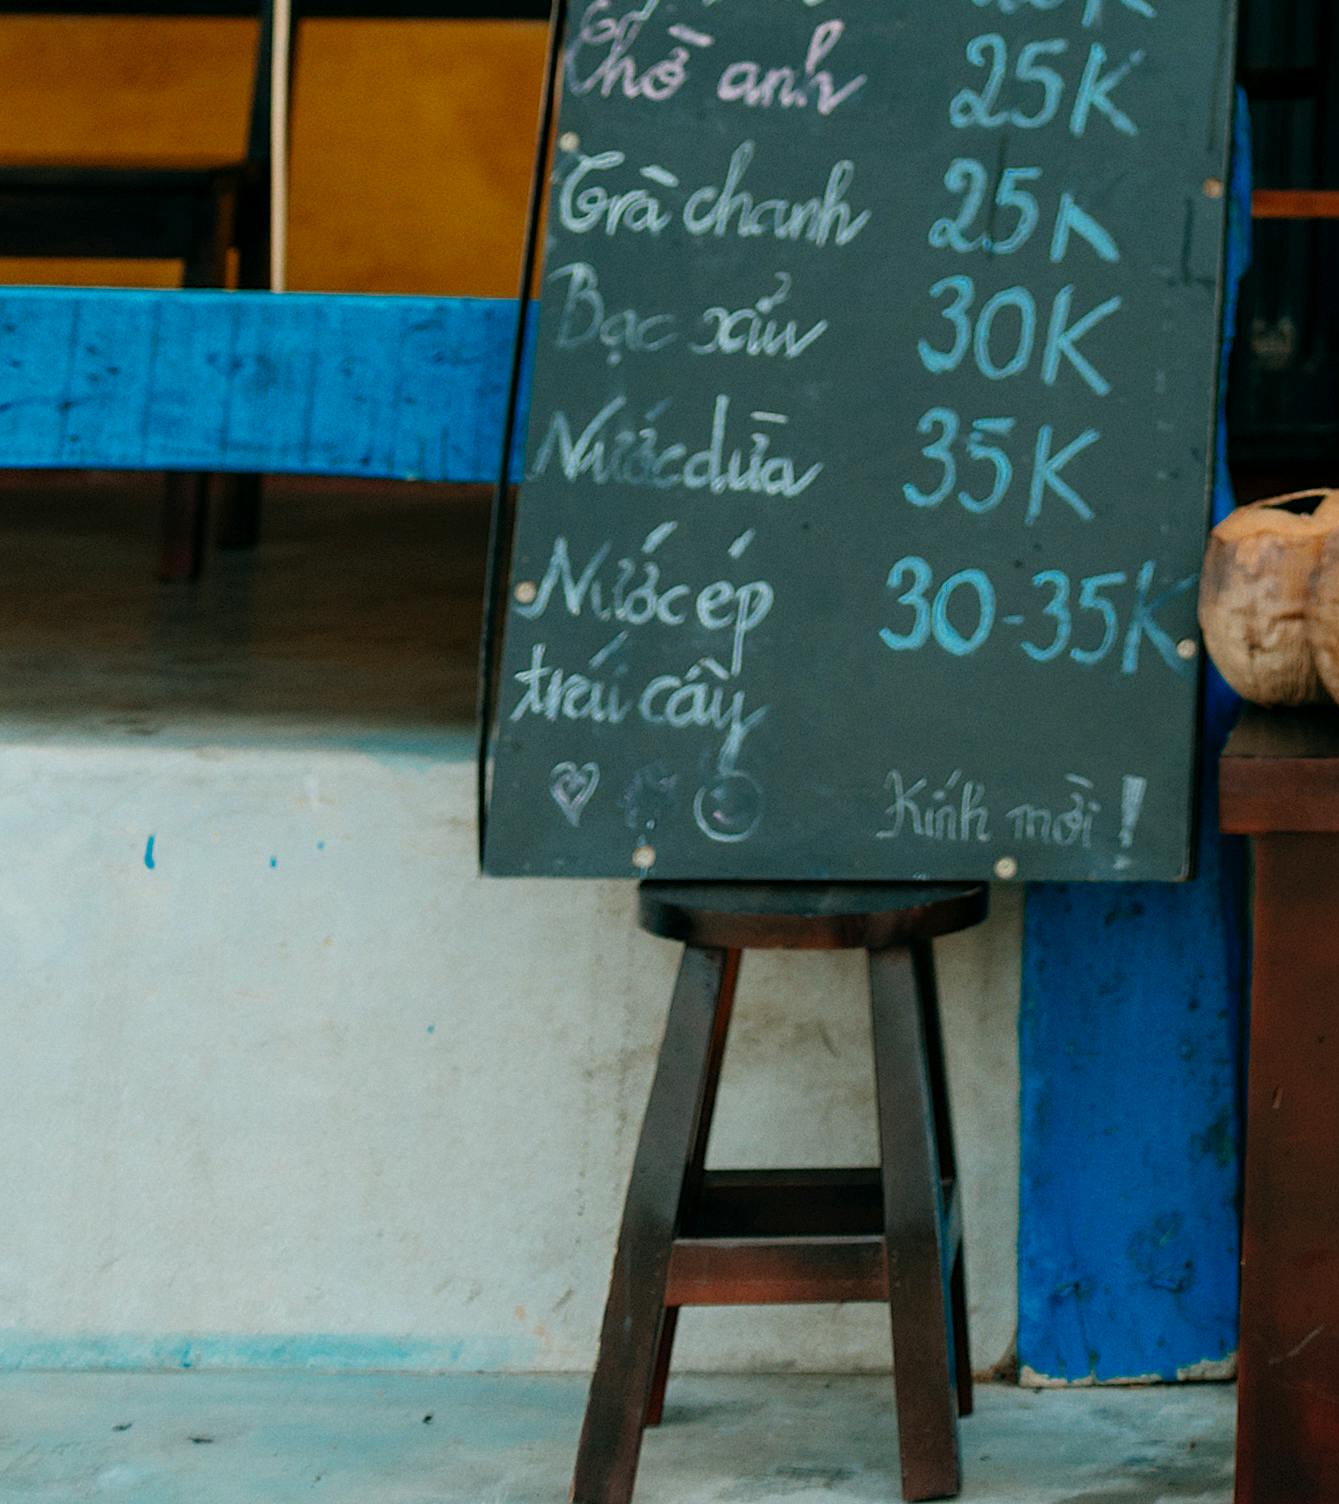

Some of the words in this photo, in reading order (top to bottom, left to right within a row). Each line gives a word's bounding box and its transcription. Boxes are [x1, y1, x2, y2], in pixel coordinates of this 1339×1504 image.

[948, 32, 1145, 136] 25K
[682, 139, 873, 247] chanh
[916, 274, 1123, 396] 30K
[682, 393, 824, 499] dừa
[902, 405, 1101, 525] 35K
[695, 526, 775, 677] ép
[637, 656, 771, 775] cây
[875, 767, 991, 844] Kính
